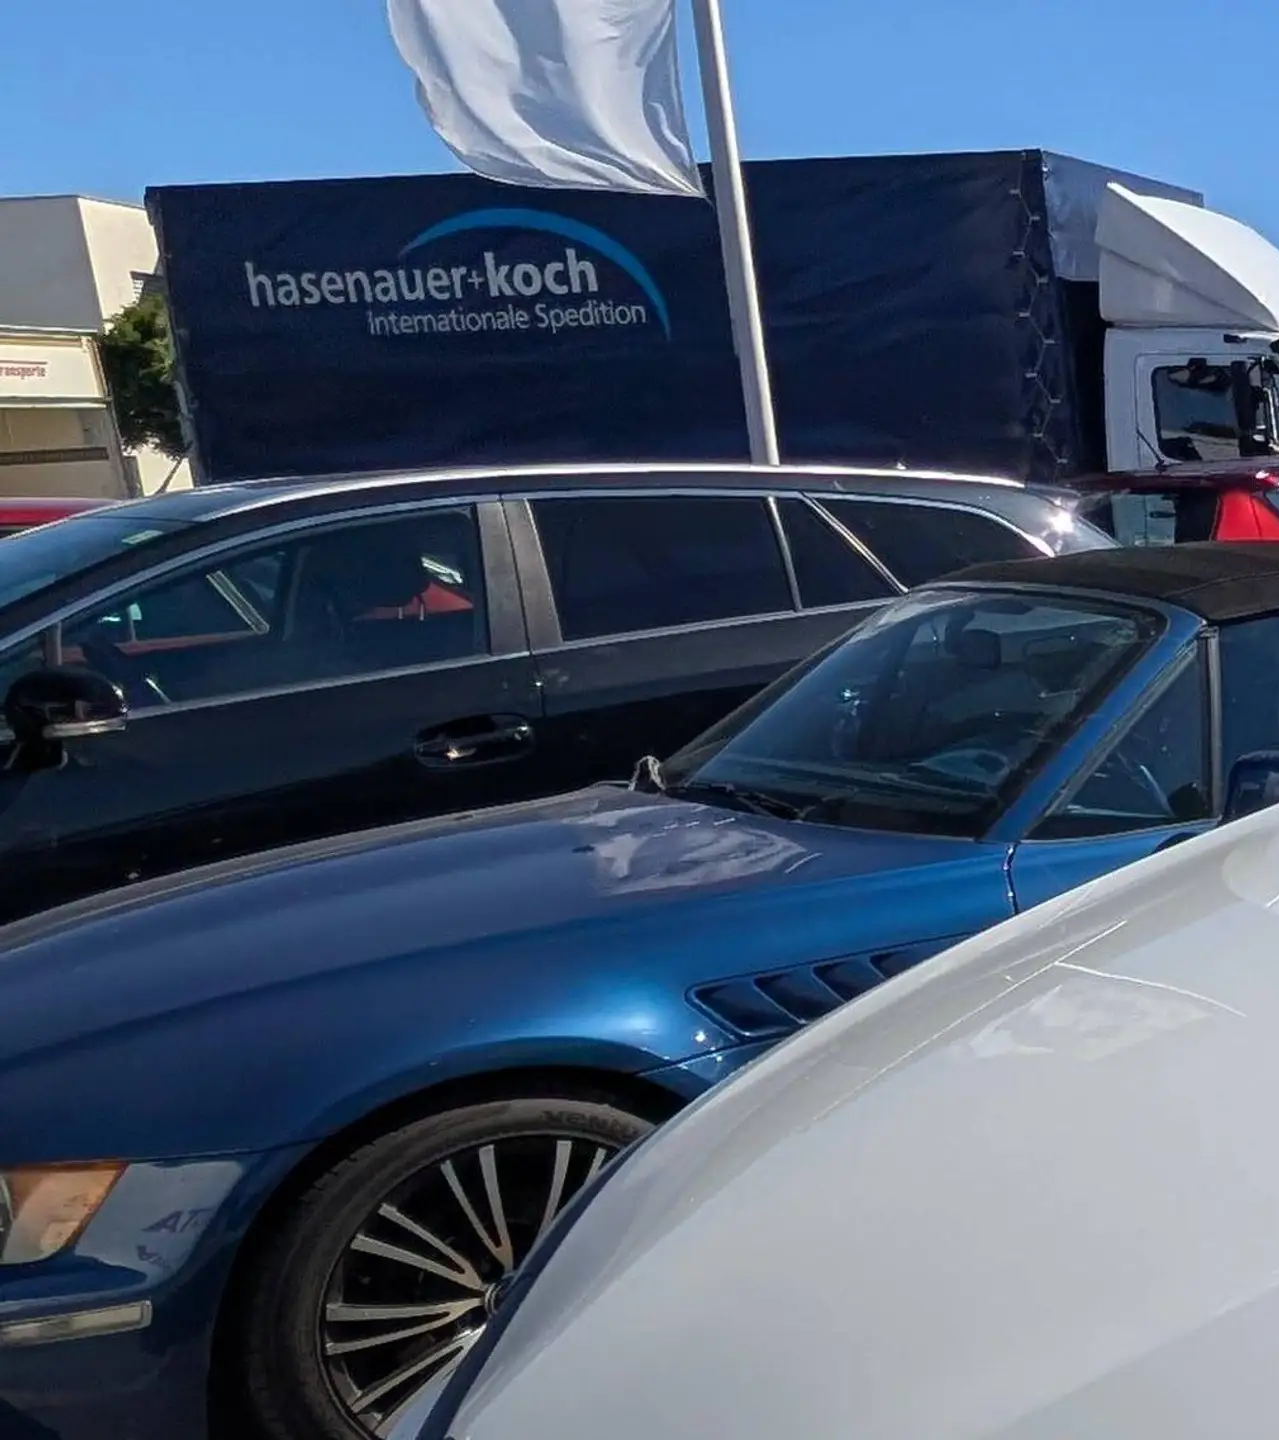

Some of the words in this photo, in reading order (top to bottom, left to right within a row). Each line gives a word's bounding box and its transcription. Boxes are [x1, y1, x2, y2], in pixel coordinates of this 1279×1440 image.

[244, 248, 599, 307] hasenauer+koch
[367, 306, 530, 336] Internationale
[536, 300, 647, 334] Spedition
